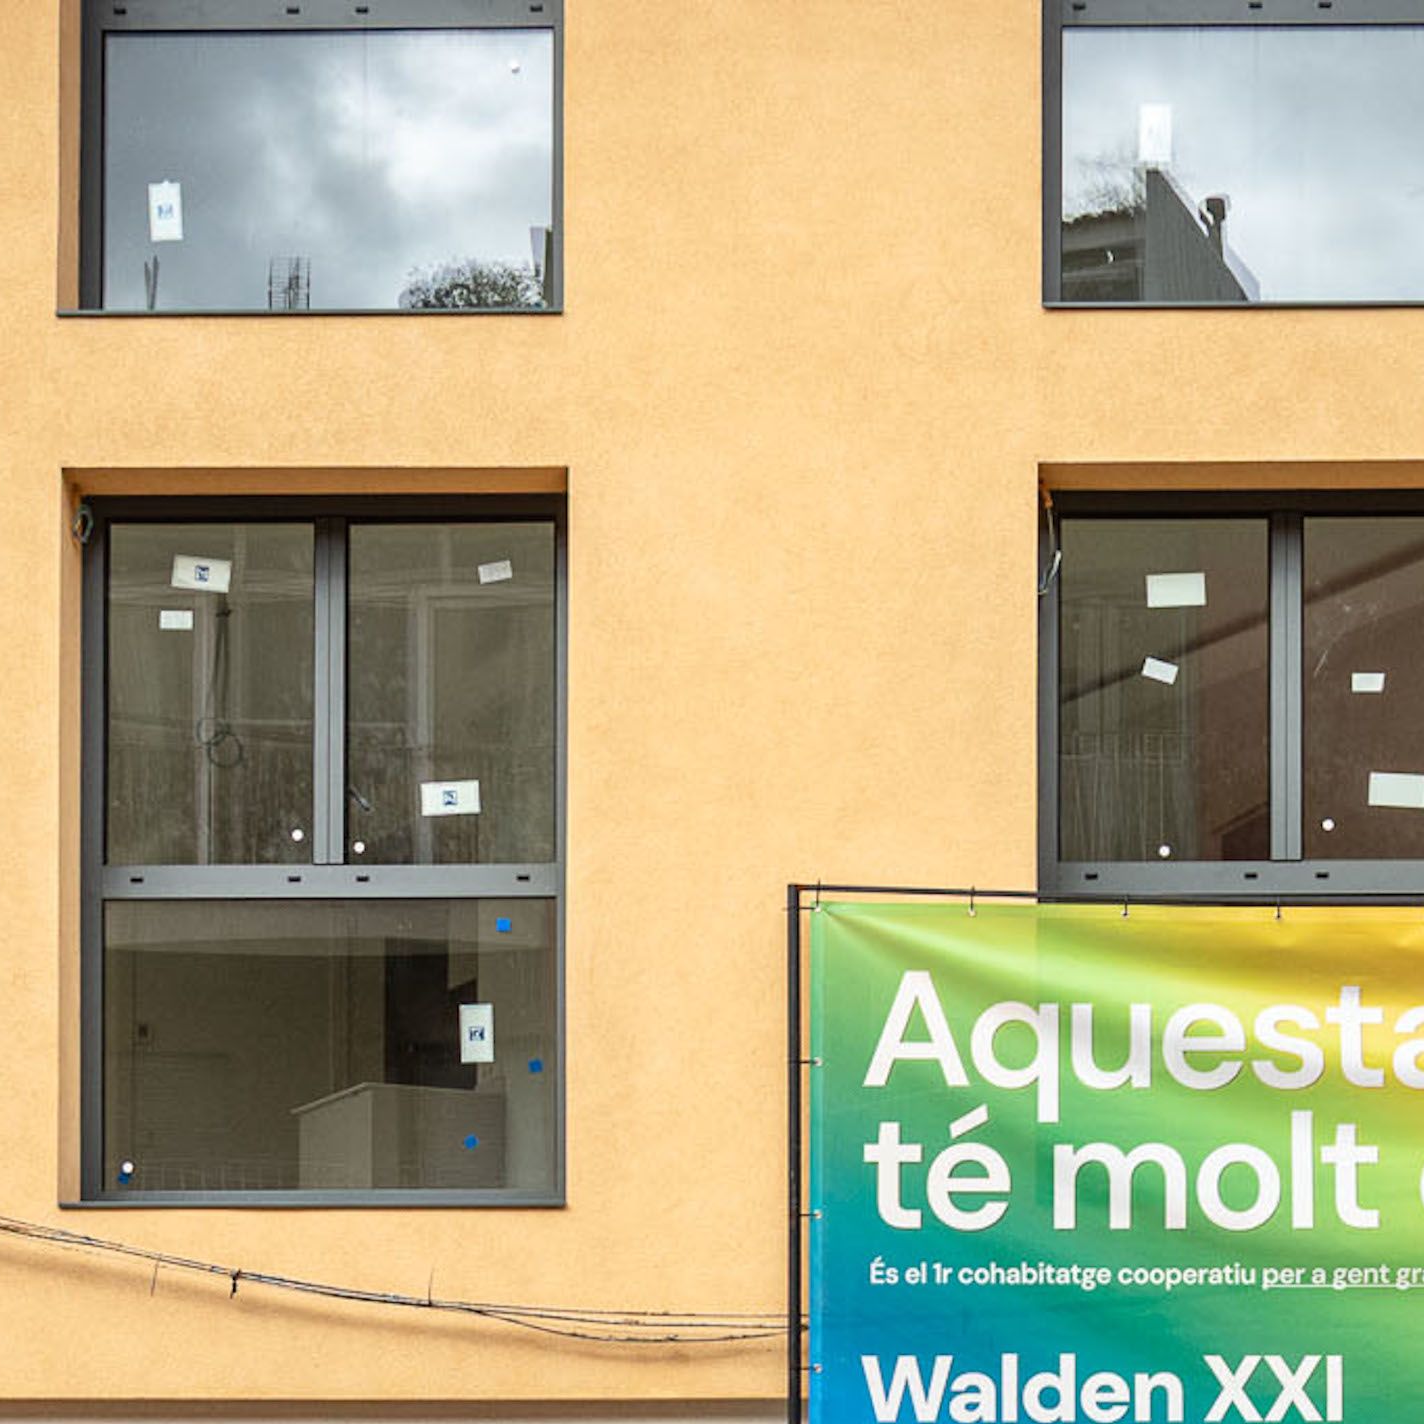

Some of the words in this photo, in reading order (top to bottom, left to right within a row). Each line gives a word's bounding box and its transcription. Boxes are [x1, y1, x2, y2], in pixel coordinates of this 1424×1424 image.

[863, 1105, 1011, 1229] té
[1052, 1110, 1379, 1229] molt
[870, 1256, 898, 1285] És
[904, 1262, 926, 1284] el
[933, 1263, 952, 1284] 1r
[957, 1261, 1111, 1291] cohabitatge
[1117, 1262, 1257, 1291] cooperatiu
[1262, 1265, 1305, 1290] per
[1311, 1266, 1326, 1284] a
[1333, 1264, 1391, 1290] gent
[860, 1352, 1184, 1424] Walden
[1203, 1354, 1344, 1423] XXI
